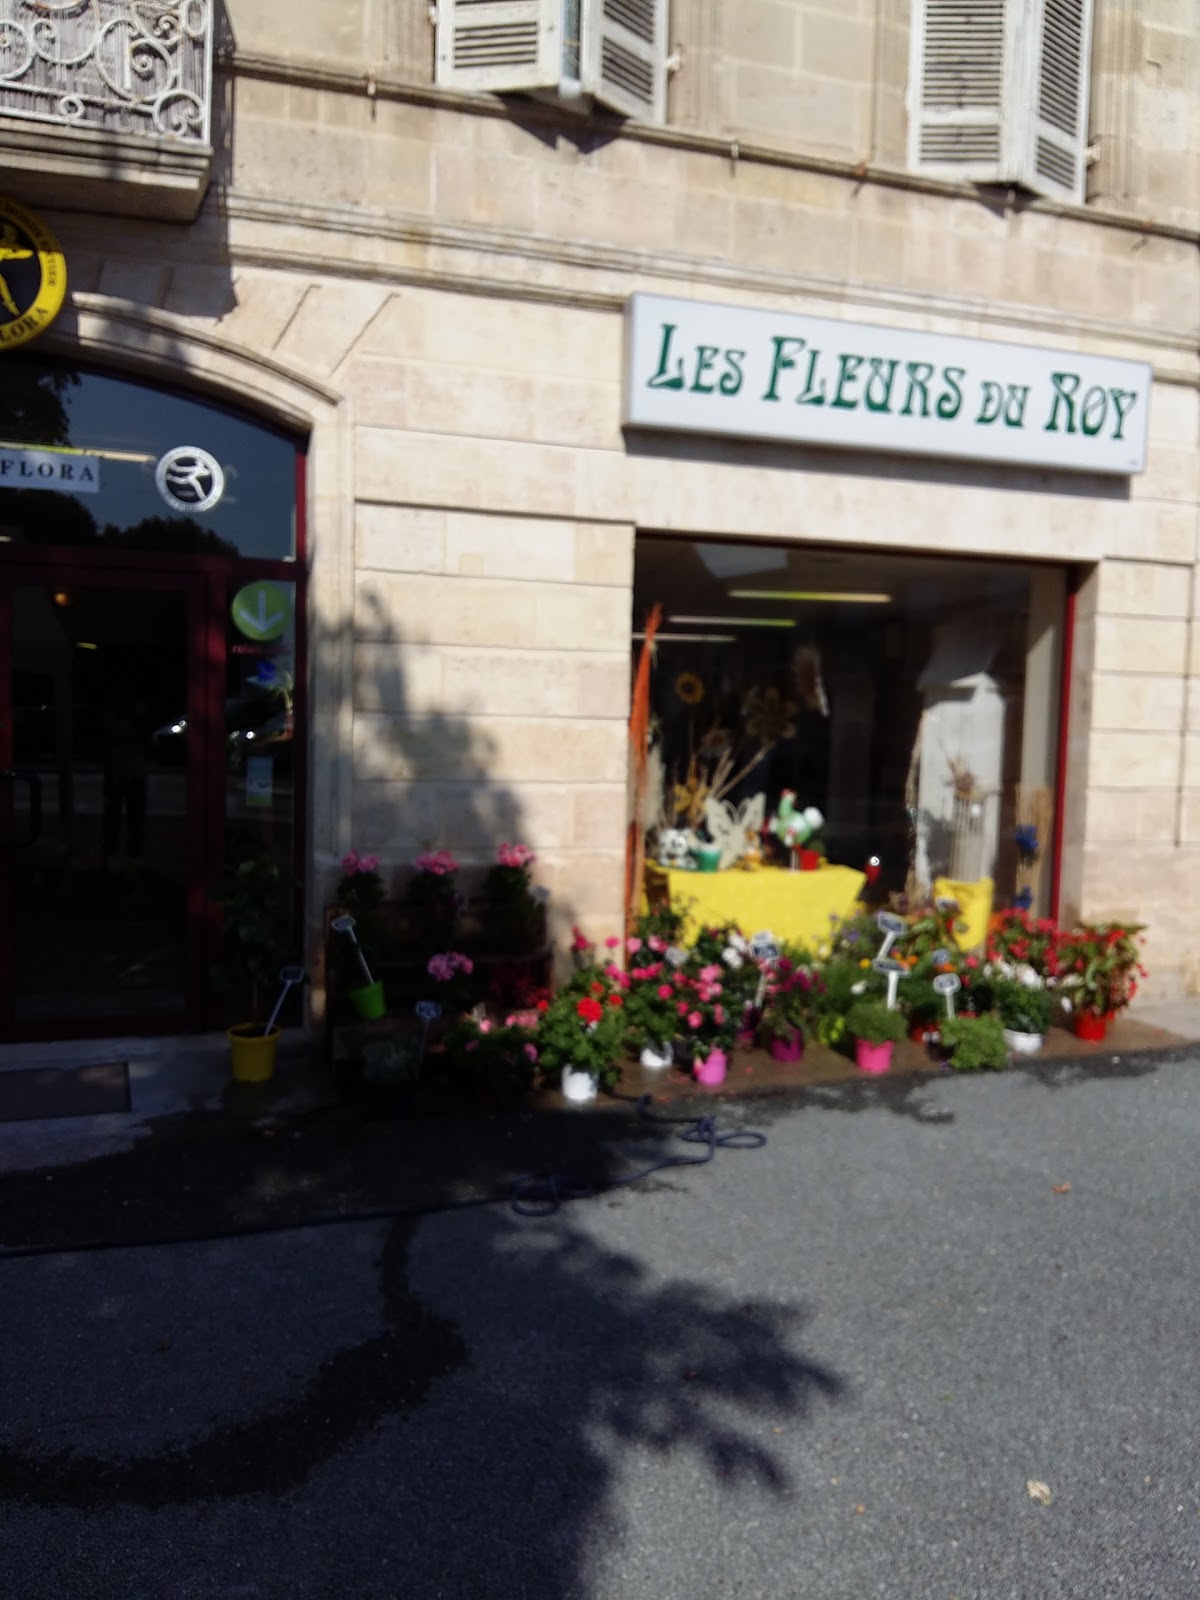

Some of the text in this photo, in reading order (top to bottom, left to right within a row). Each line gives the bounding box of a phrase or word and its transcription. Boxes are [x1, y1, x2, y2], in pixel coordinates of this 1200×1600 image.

[647, 322, 1138, 440] LES FLEURS DU ROY
[0, 457, 95, 482] FLORA
